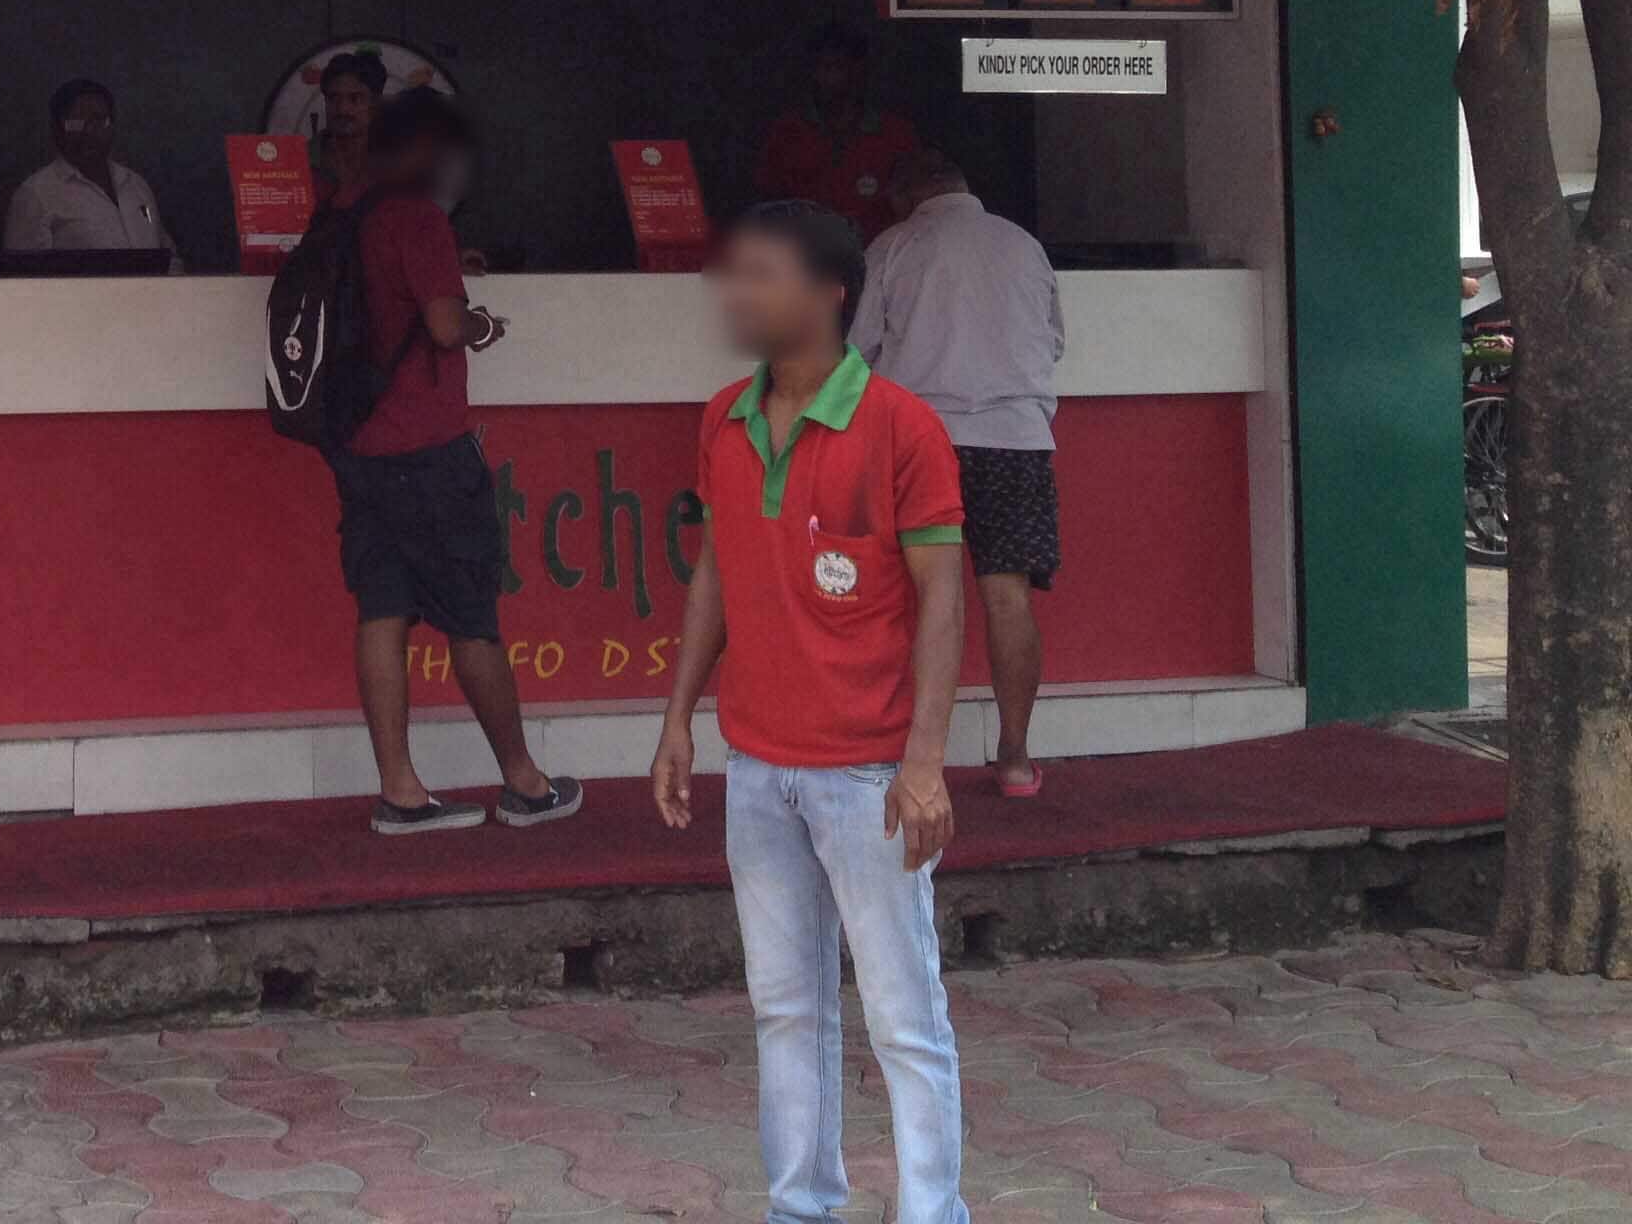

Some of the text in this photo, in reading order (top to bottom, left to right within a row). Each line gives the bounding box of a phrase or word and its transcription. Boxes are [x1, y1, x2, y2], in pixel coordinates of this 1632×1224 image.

[977, 54, 1154, 77] KINDLY PICK YOUR ORDER HERE
[508, 638, 631, 679] FOD
